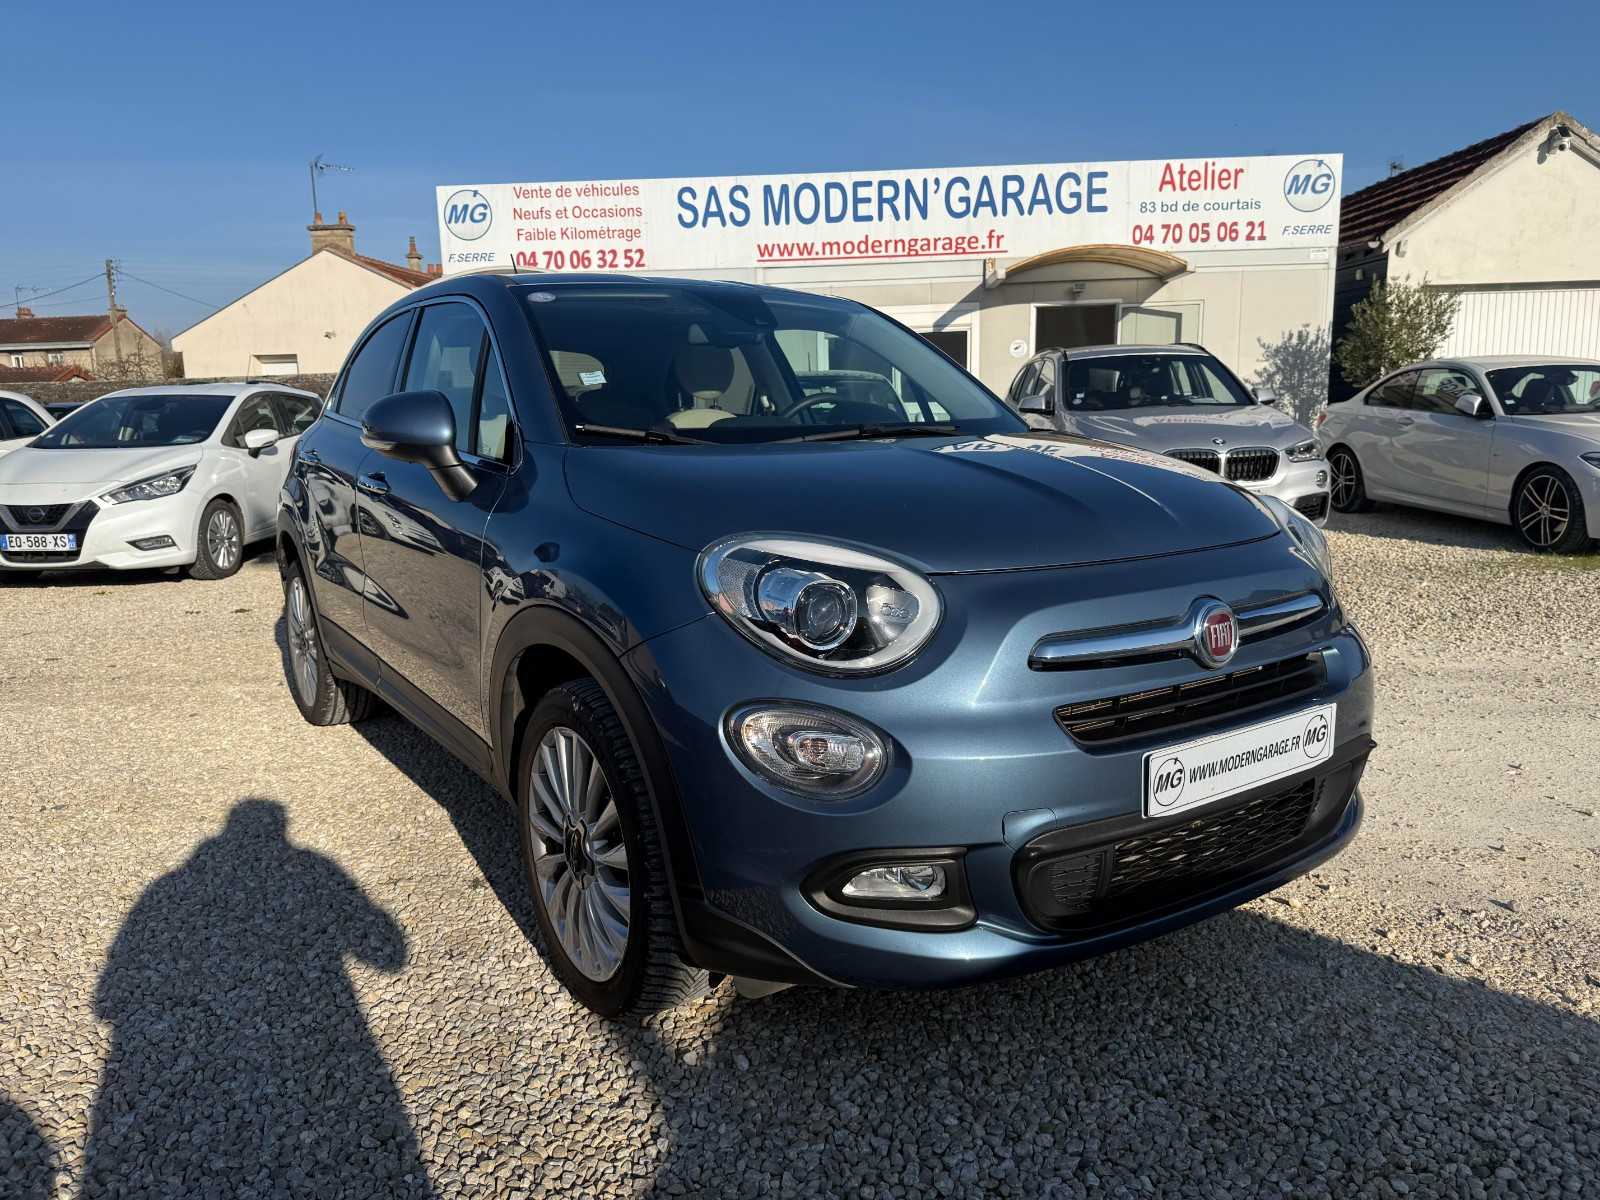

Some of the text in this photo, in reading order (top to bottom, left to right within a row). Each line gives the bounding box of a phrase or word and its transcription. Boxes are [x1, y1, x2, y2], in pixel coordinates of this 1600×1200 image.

[1158, 161, 1244, 193] Atelier
[1286, 173, 1332, 196] MG
[513, 182, 640, 199] Vente de véhicules
[447, 202, 489, 225] MG
[513, 205, 643, 220] Neufs et Occasions
[676, 184, 751, 229] SAS
[1139, 198, 1261, 213] 83 bd de courtais
[516, 226, 642, 241] Faible Kilométrage
[1132, 221, 1267, 244] 04 70 05 06 21
[1282, 224, 1333, 236] F.SERRE
[756, 229, 1005, 259] www.moderngarage.fr
[448, 252, 496, 263] F.SERRE
[516, 248, 646, 270] 04 70 06 32 52
[1210, 621, 1231, 649] FIAT
[1154, 723, 1328, 795] MG WWW.MODERNGARAGE.FR MG
